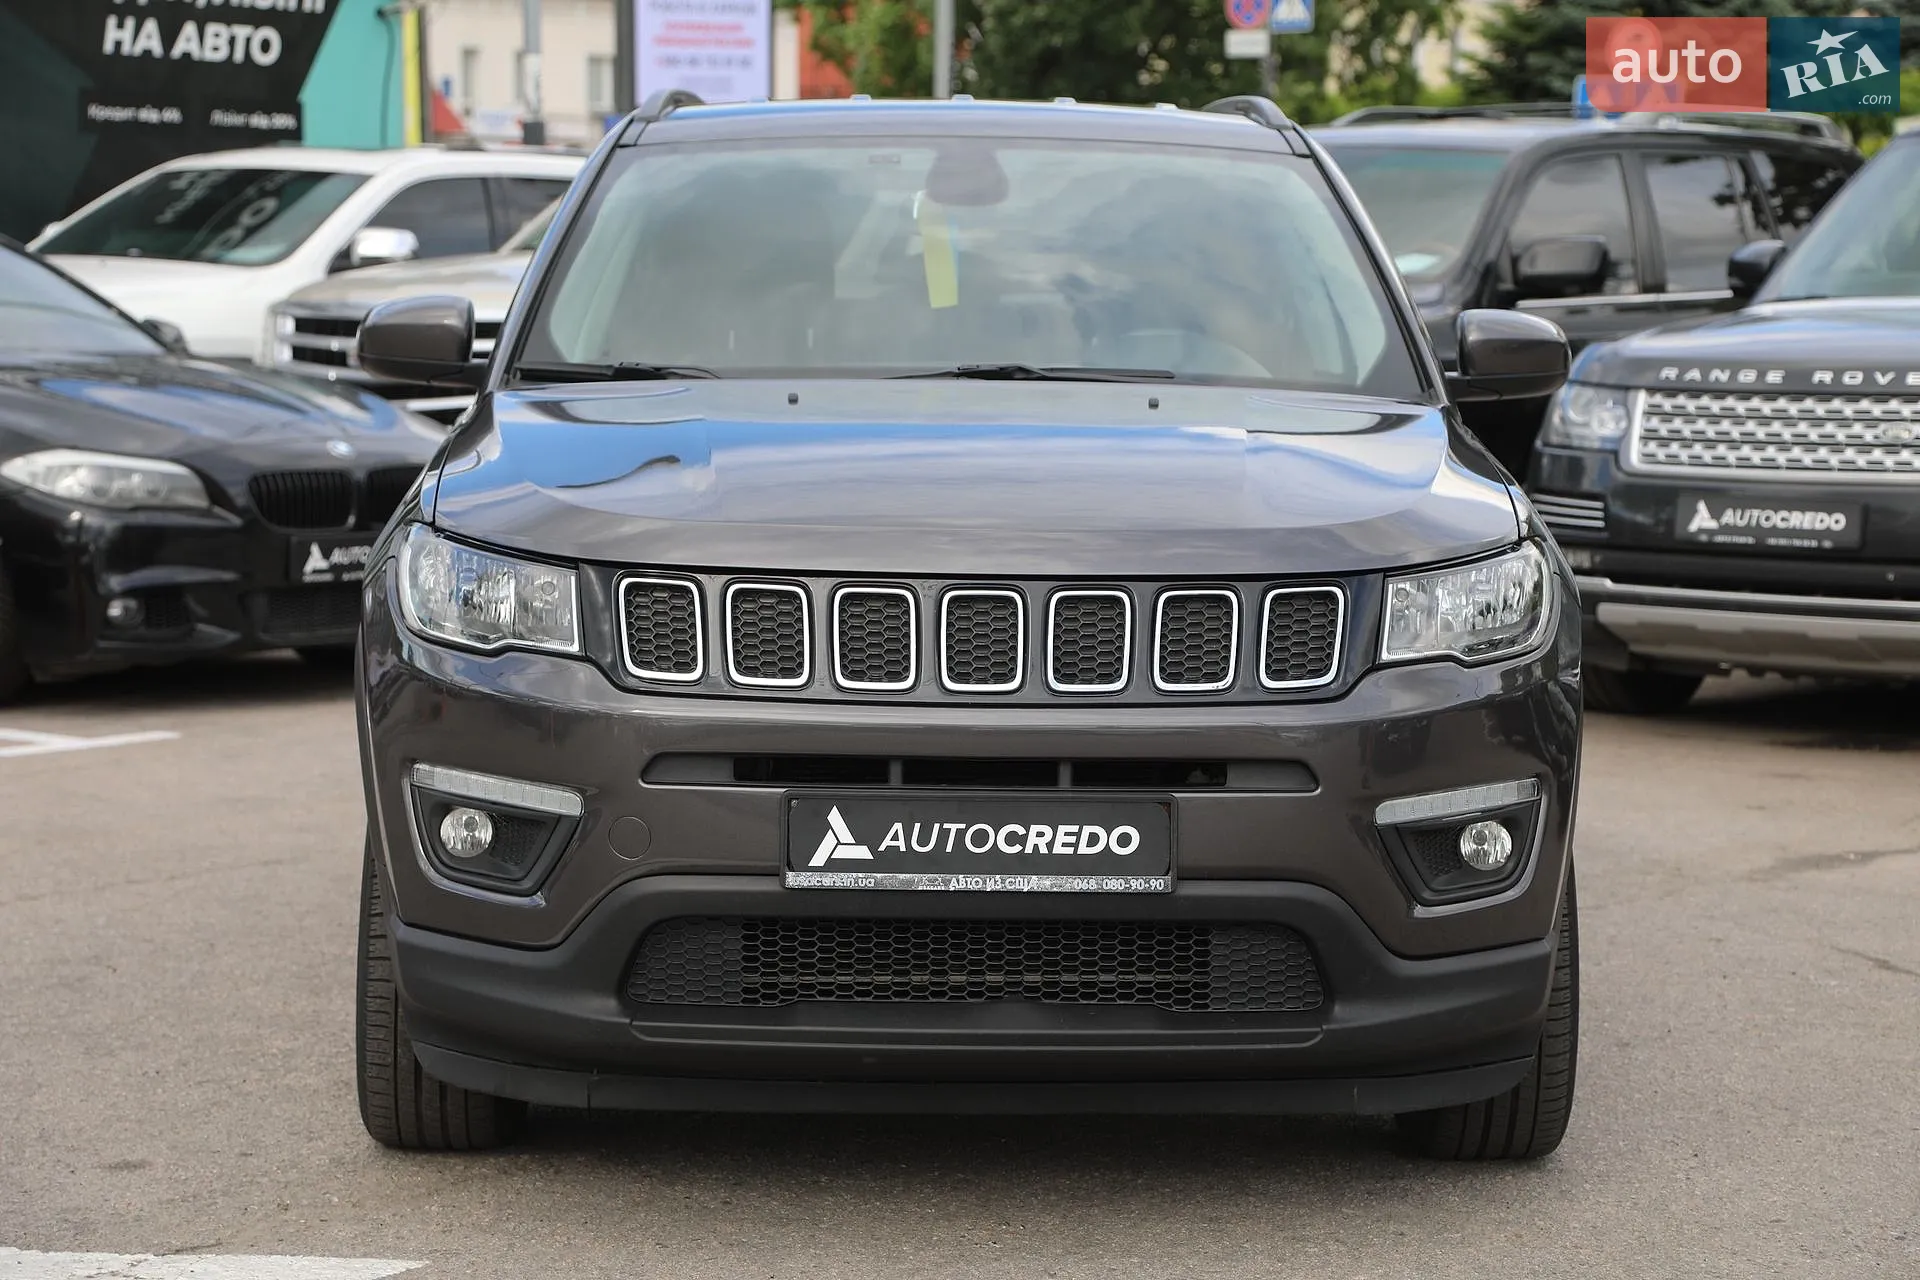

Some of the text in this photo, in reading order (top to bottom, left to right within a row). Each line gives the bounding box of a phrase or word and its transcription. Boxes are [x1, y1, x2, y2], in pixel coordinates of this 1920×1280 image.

[102, 13, 283, 67] НА АВТО
[1658, 366, 1786, 384] RANGE
[1719, 507, 1846, 531] AUTOCREDO
[877, 822, 1141, 856] AUTOCREDO
[949, 877, 983, 889] АВТО
[986, 877, 1001, 890] ИЗ
[1074, 878, 1165, 890] 068 080-90-90
